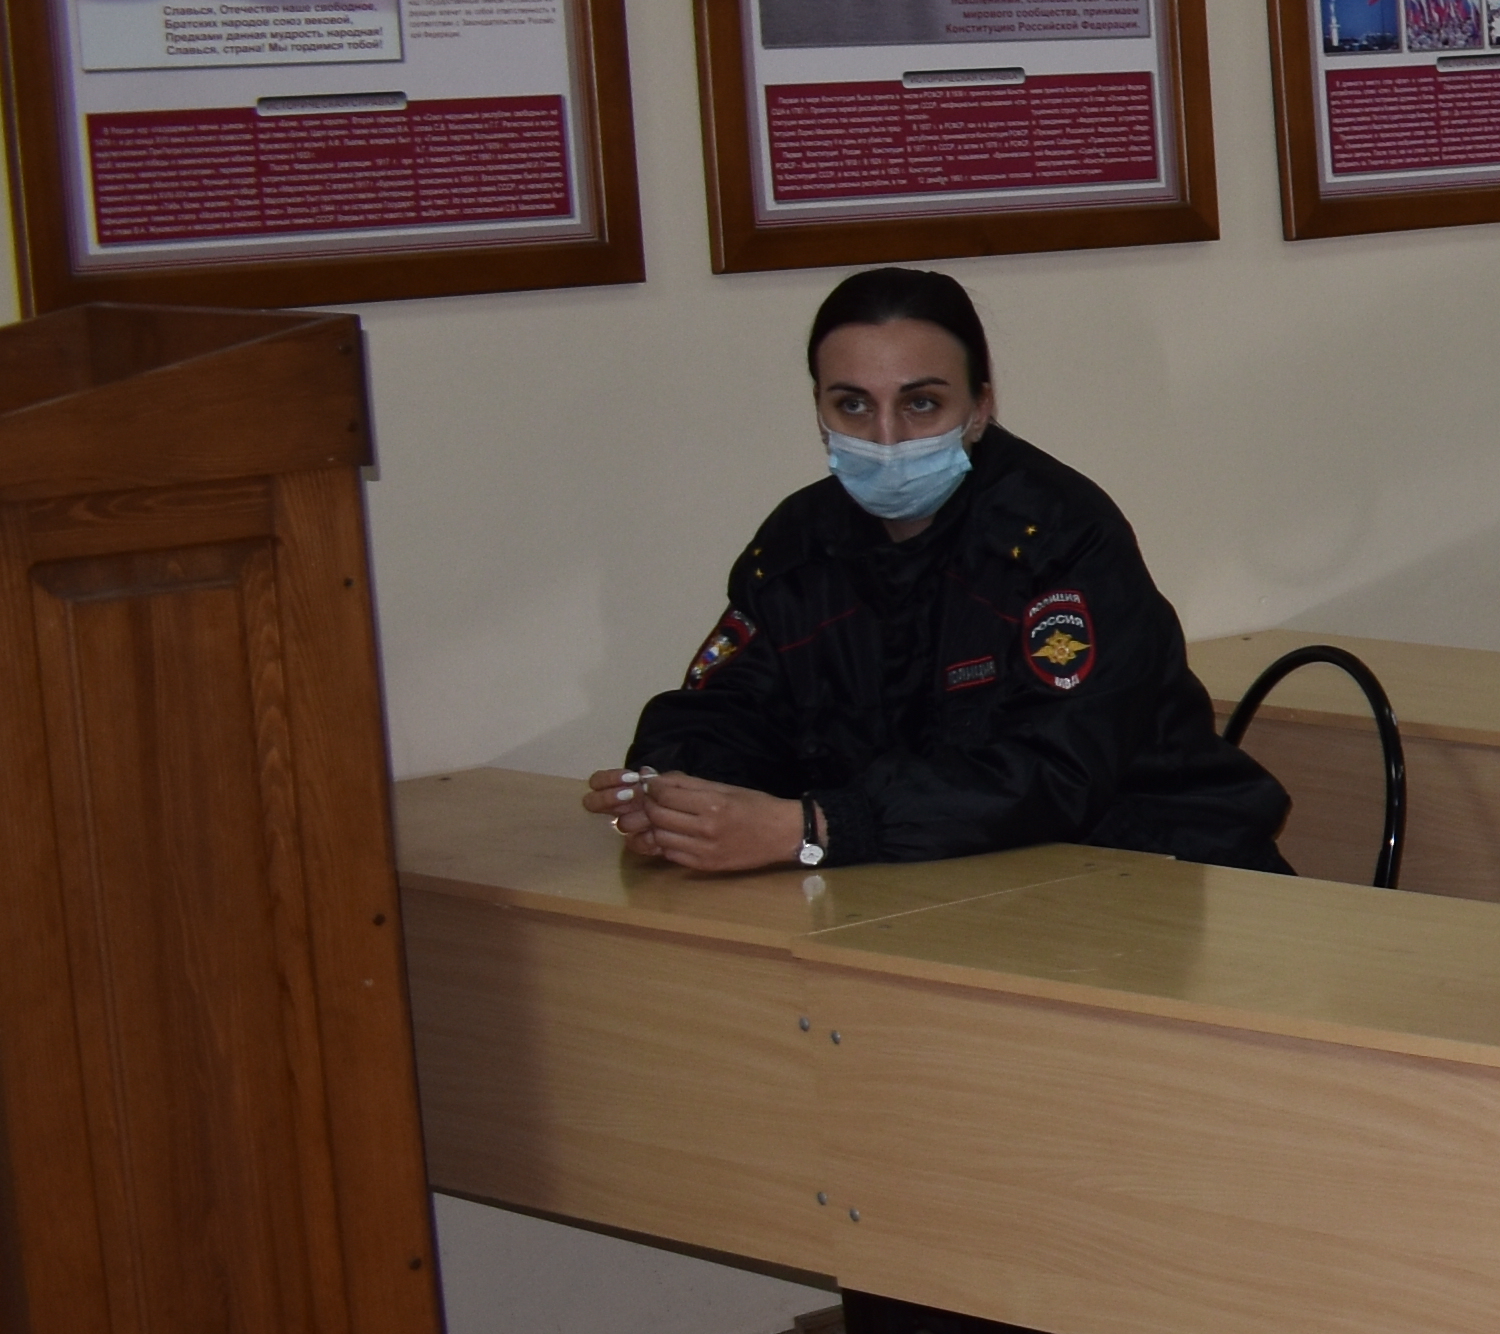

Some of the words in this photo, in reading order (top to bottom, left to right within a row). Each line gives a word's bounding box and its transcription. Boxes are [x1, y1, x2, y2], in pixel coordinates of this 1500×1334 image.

[164, 5, 216, 17] Славься,
[219, 4, 281, 14] Отечество
[280, 5, 313, 13] наше
[312, 2, 378, 15] свободное,
[165, 18, 217, 30] Братских
[220, 19, 270, 29] народов
[303, 15, 354, 28] вековой,
[166, 31, 223, 44] Предками
[225, 32, 267, 42] данная
[269, 31, 323, 41] мудрость
[326, 27, 383, 40] народная!
[167, 44, 220, 57] Славься,
[222, 43, 267, 55] страна!
[267, 42, 288, 52] Мы
[290, 43, 344, 54] гордимся
[346, 40, 383, 50] тобой!
[1029, 593, 1081, 617] ПОЛИЦИЯ
[1031, 614, 1084, 638] РОССИЯ
[1054, 675, 1080, 689] МВД
